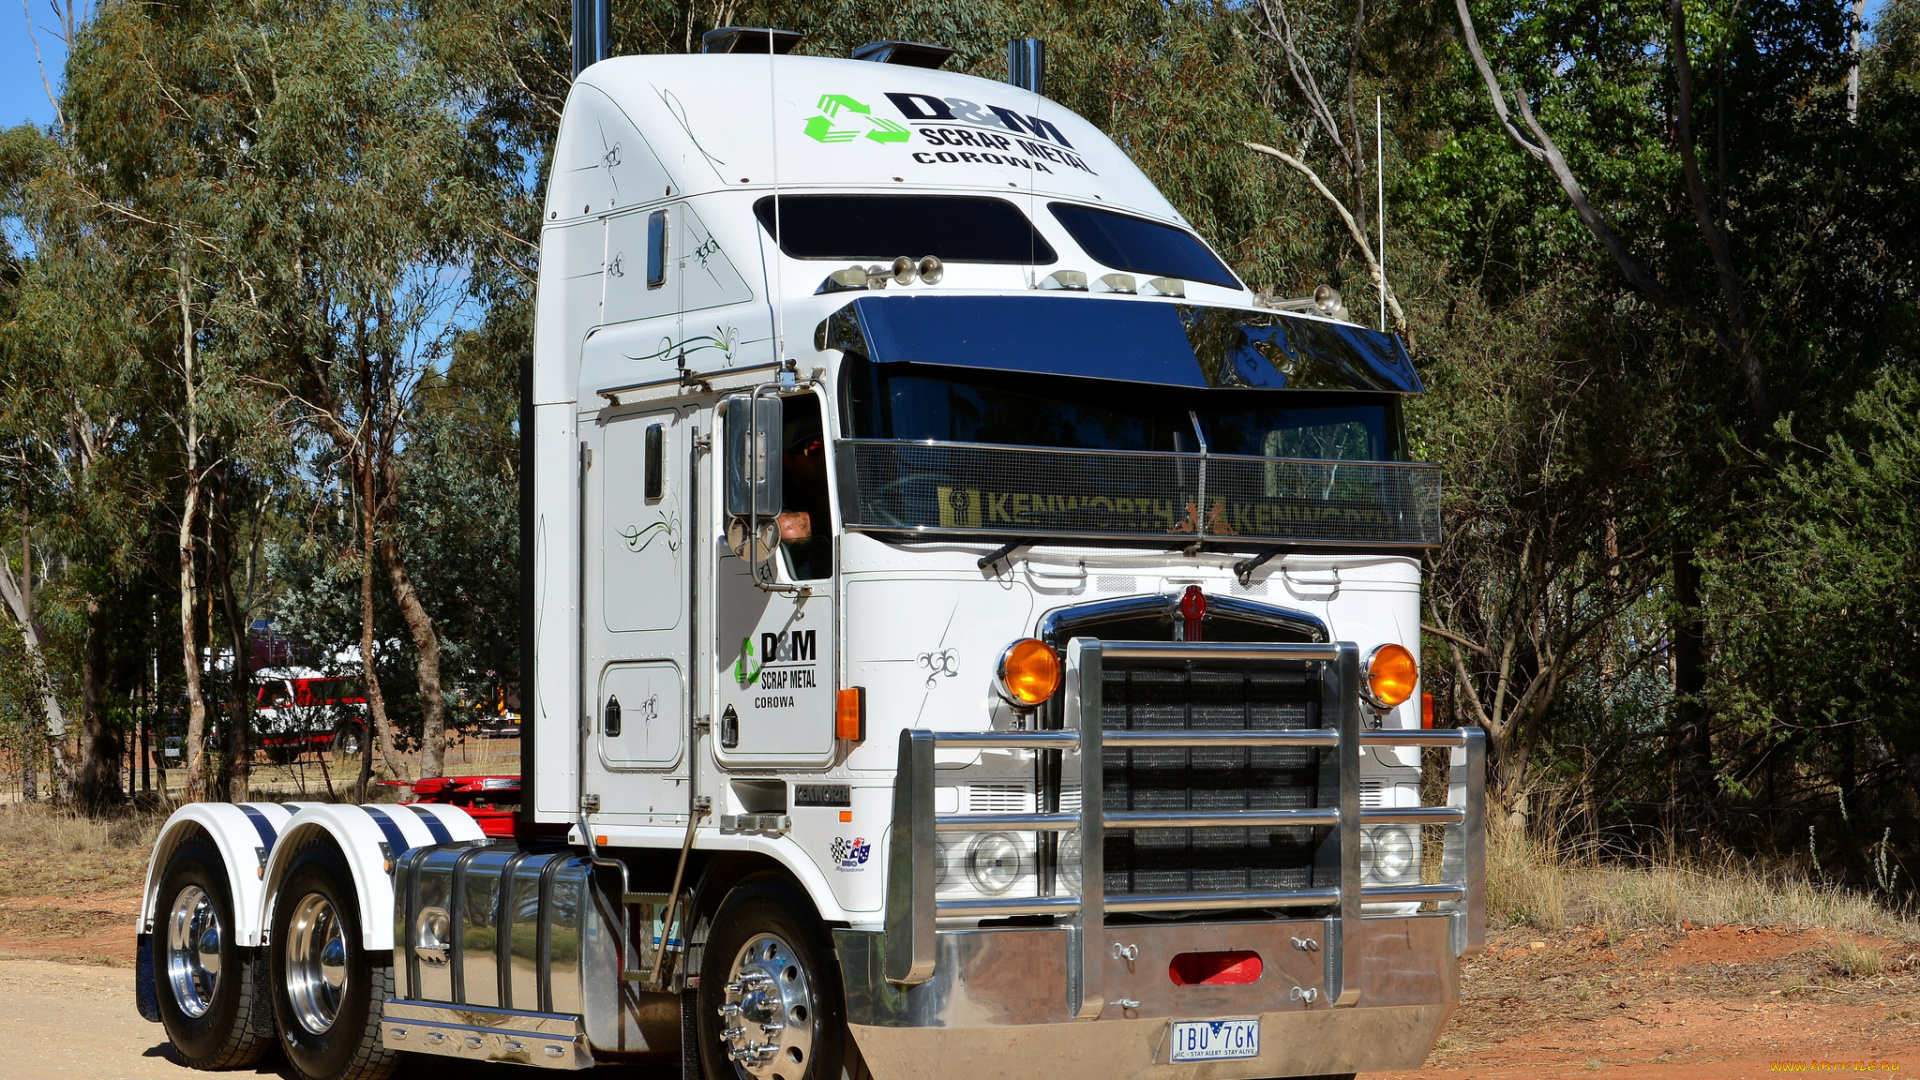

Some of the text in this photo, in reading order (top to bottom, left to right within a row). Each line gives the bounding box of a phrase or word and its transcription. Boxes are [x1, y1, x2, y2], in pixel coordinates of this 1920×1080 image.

[883, 92, 1076, 150] D&M
[911, 151, 1055, 175] COROWA
[918, 128, 1099, 177] SCRAP METAL
[761, 629, 817, 663] D&M
[761, 669, 817, 690] SCRAP METAL
[754, 695, 795, 709] COROWA
[796, 785, 849, 802] KENWORTH
[1178, 1025, 1255, 1051] 1BU 7GK
